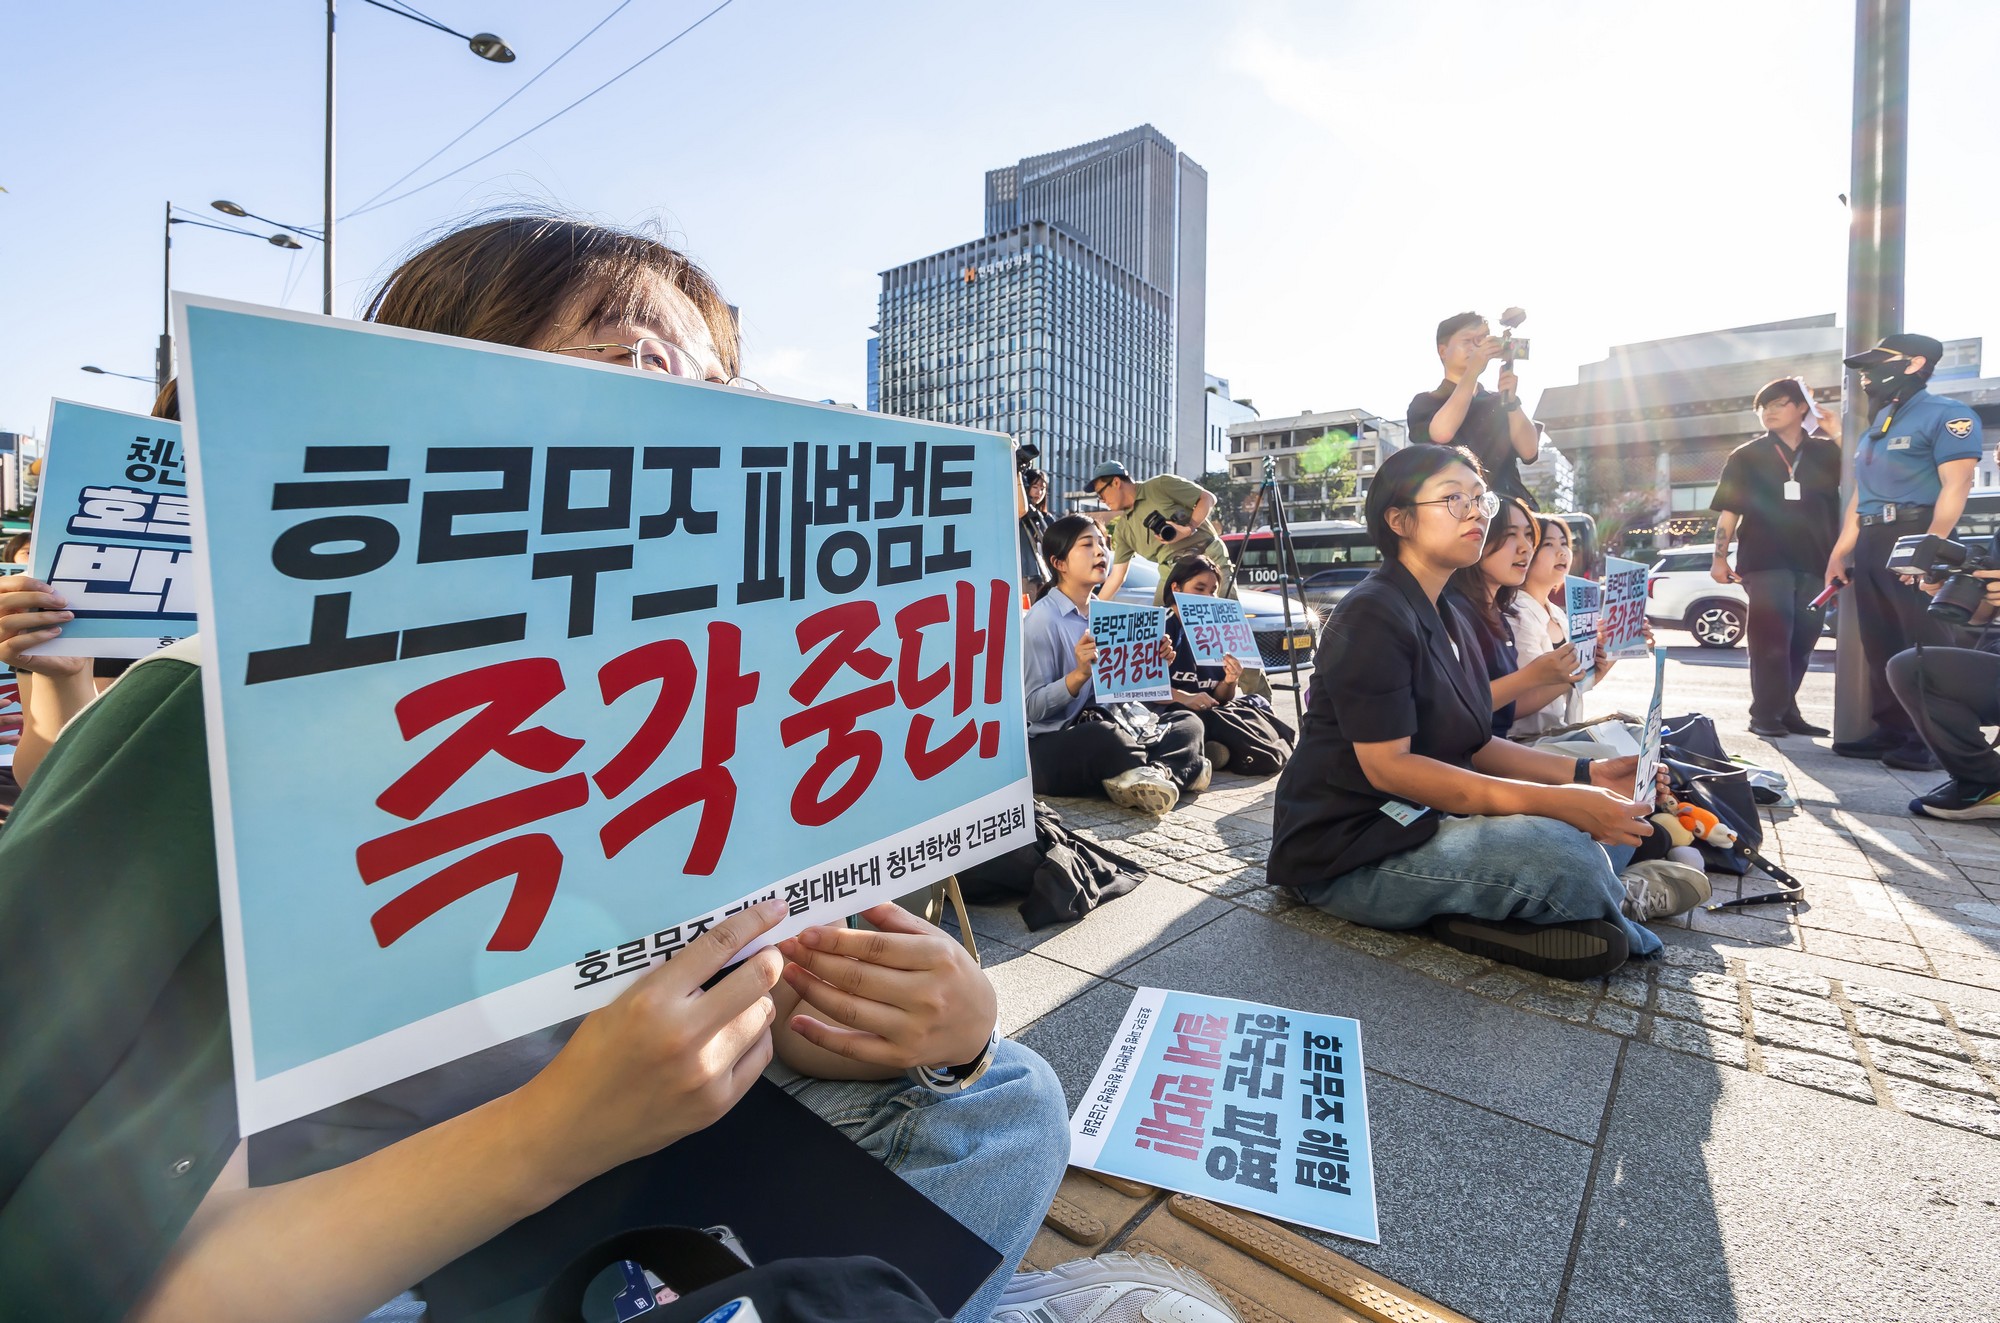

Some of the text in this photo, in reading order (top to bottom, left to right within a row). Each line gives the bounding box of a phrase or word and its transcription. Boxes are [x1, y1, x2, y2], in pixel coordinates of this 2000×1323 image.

[246, 441, 975, 685] 호르무즈 파병검토
[1182, 604, 1211, 626] 호르무즈
[1249, 570, 1278, 582] 1000
[1093, 611, 1159, 646] 호르무즈 파병검토
[1098, 640, 1163, 689] 즉각 중단!
[1193, 625, 1223, 656] 즉각
[355, 579, 1011, 952] 즉각 중단!
[785, 855, 881, 917] 절대반대
[886, 828, 962, 880] 청년학생
[966, 804, 1026, 850] 긴급집회
[1079, 1007, 1152, 1137] 호르무즈 파병 절대반대 청년학생 긴급집회
[1135, 1012, 1230, 1161] 절대 반대!
[1205, 1012, 1291, 1194] 한국군 파병
[1295, 1031, 1352, 1196] 호르무즈 해협
